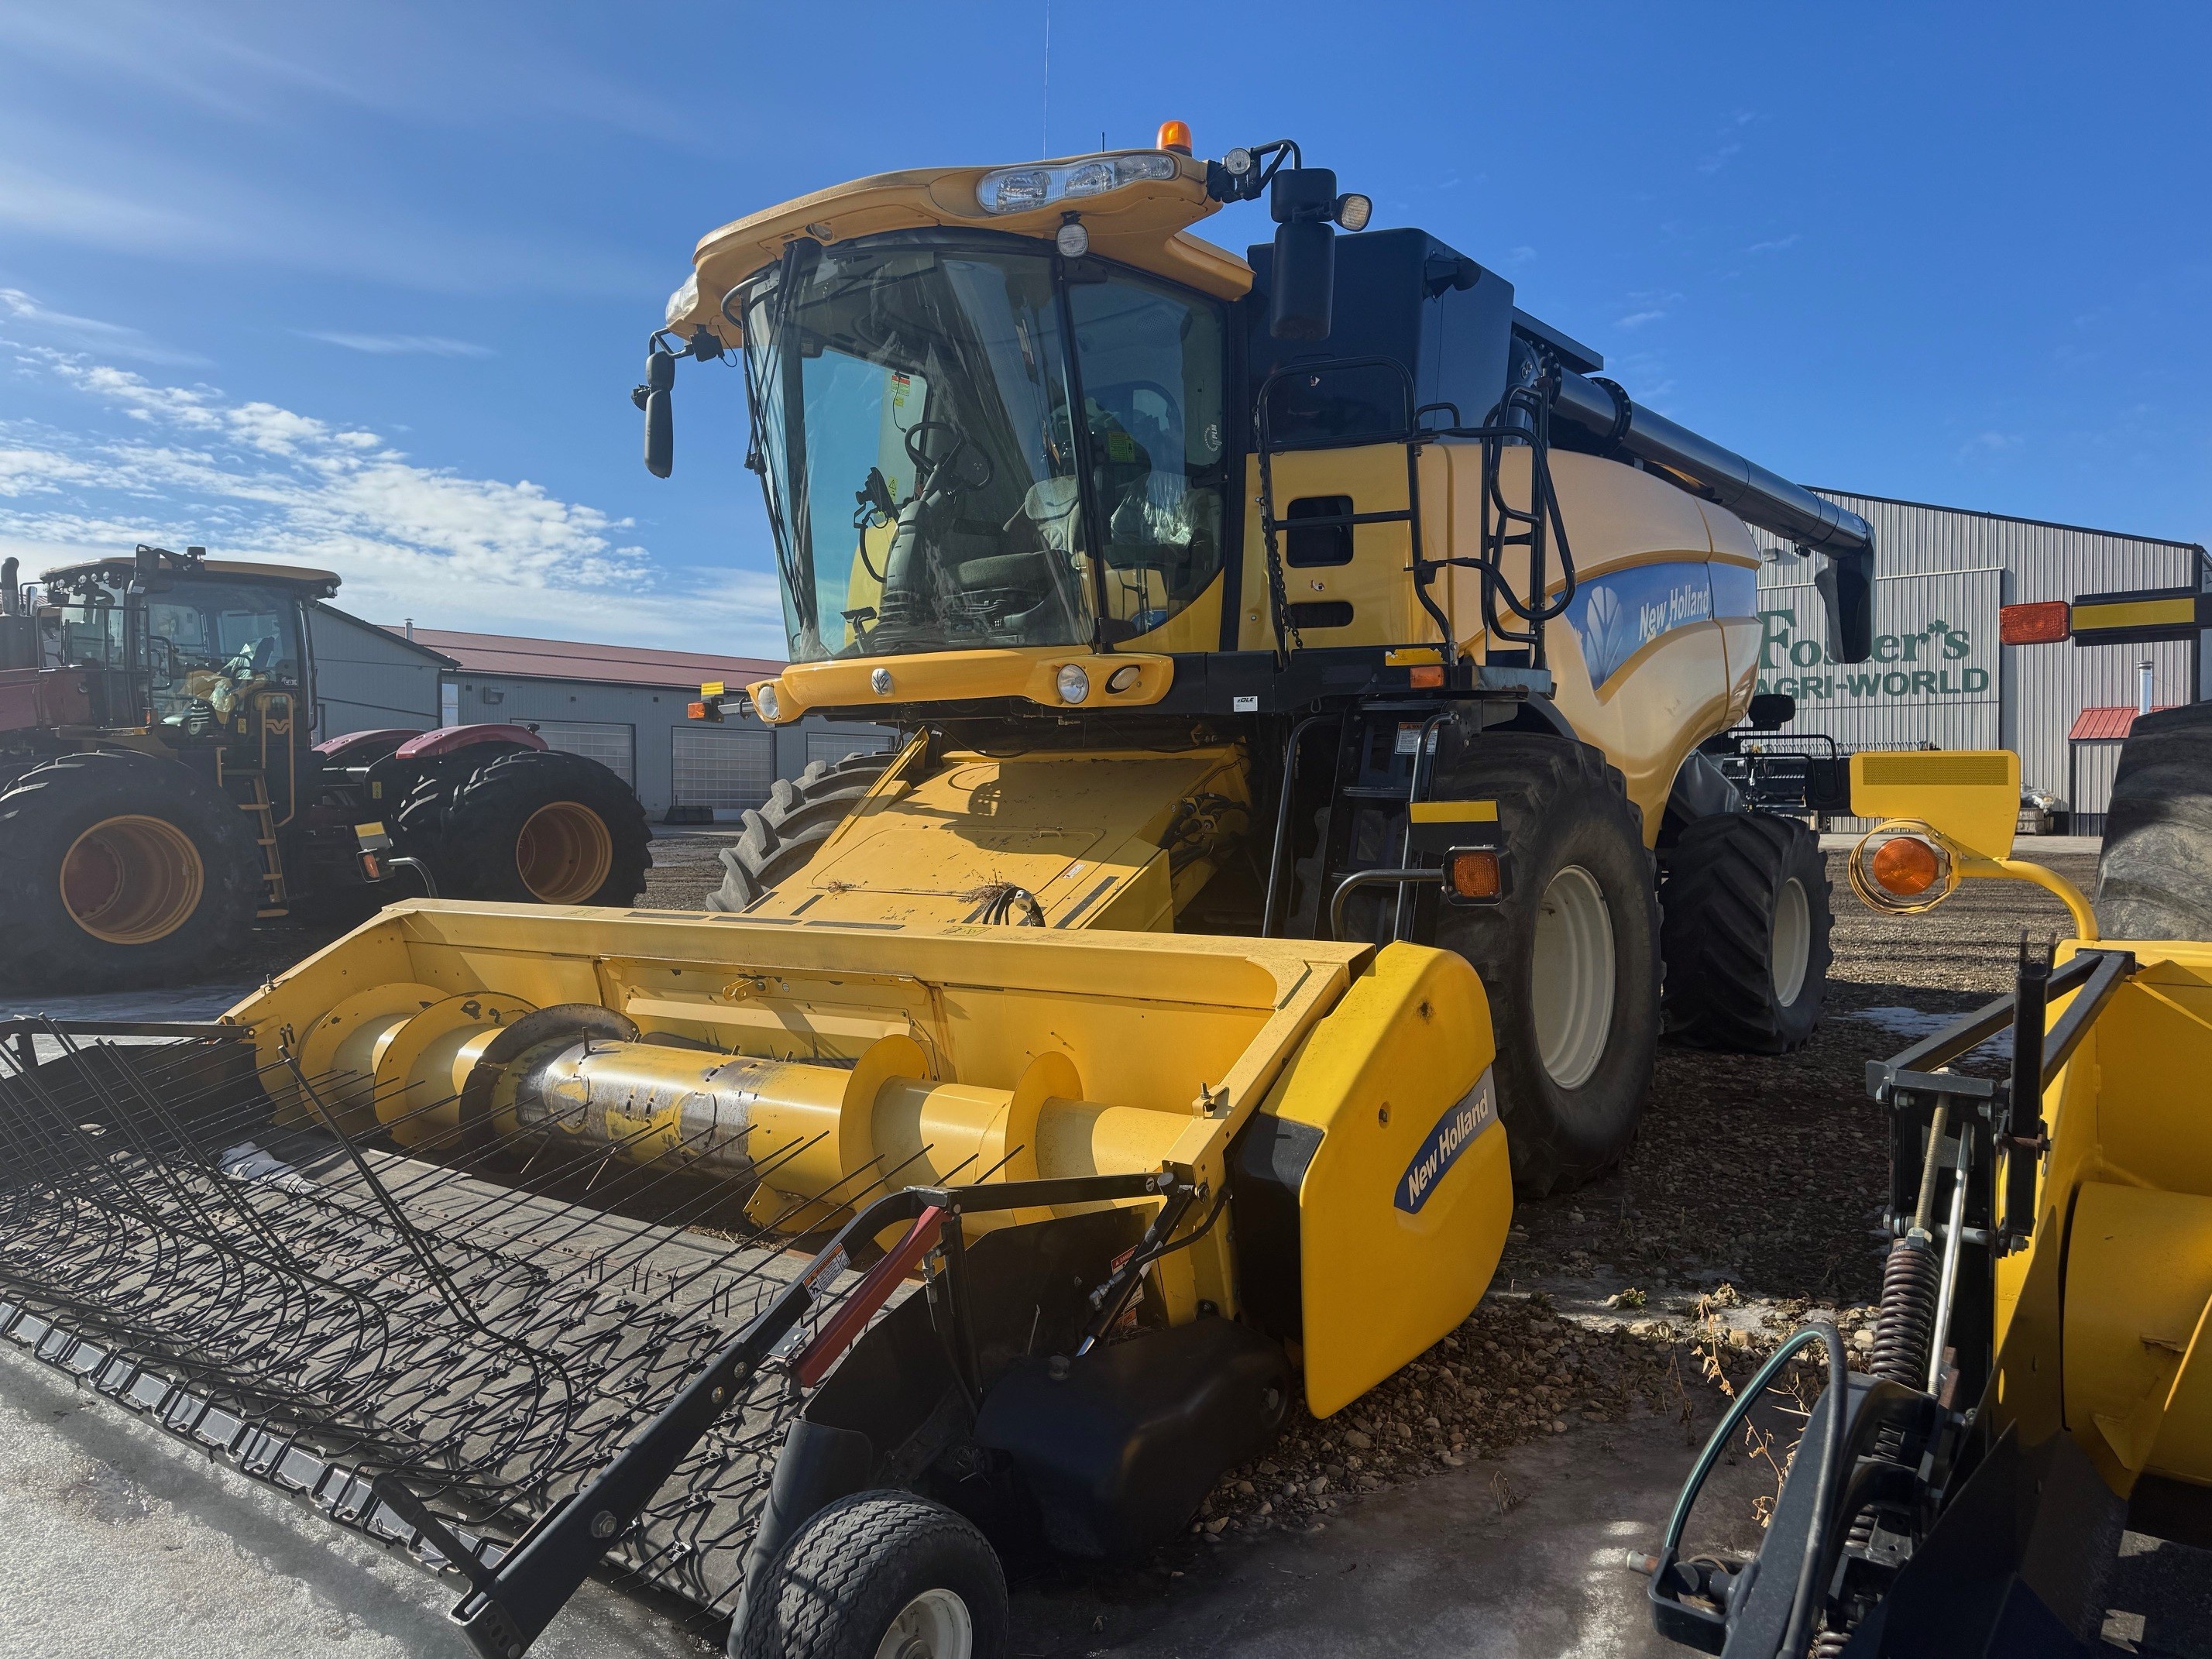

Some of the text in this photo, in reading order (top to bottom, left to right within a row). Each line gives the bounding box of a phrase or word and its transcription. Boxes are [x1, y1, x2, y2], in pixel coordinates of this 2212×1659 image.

[1639, 582, 1710, 641] New Holland
[1758, 610, 1970, 670] Foer's
[1755, 668, 1989, 699] AGRI-WORLD
[1407, 1088, 1489, 1207] New Holland
[815, 1252, 836, 1274] WARNING
